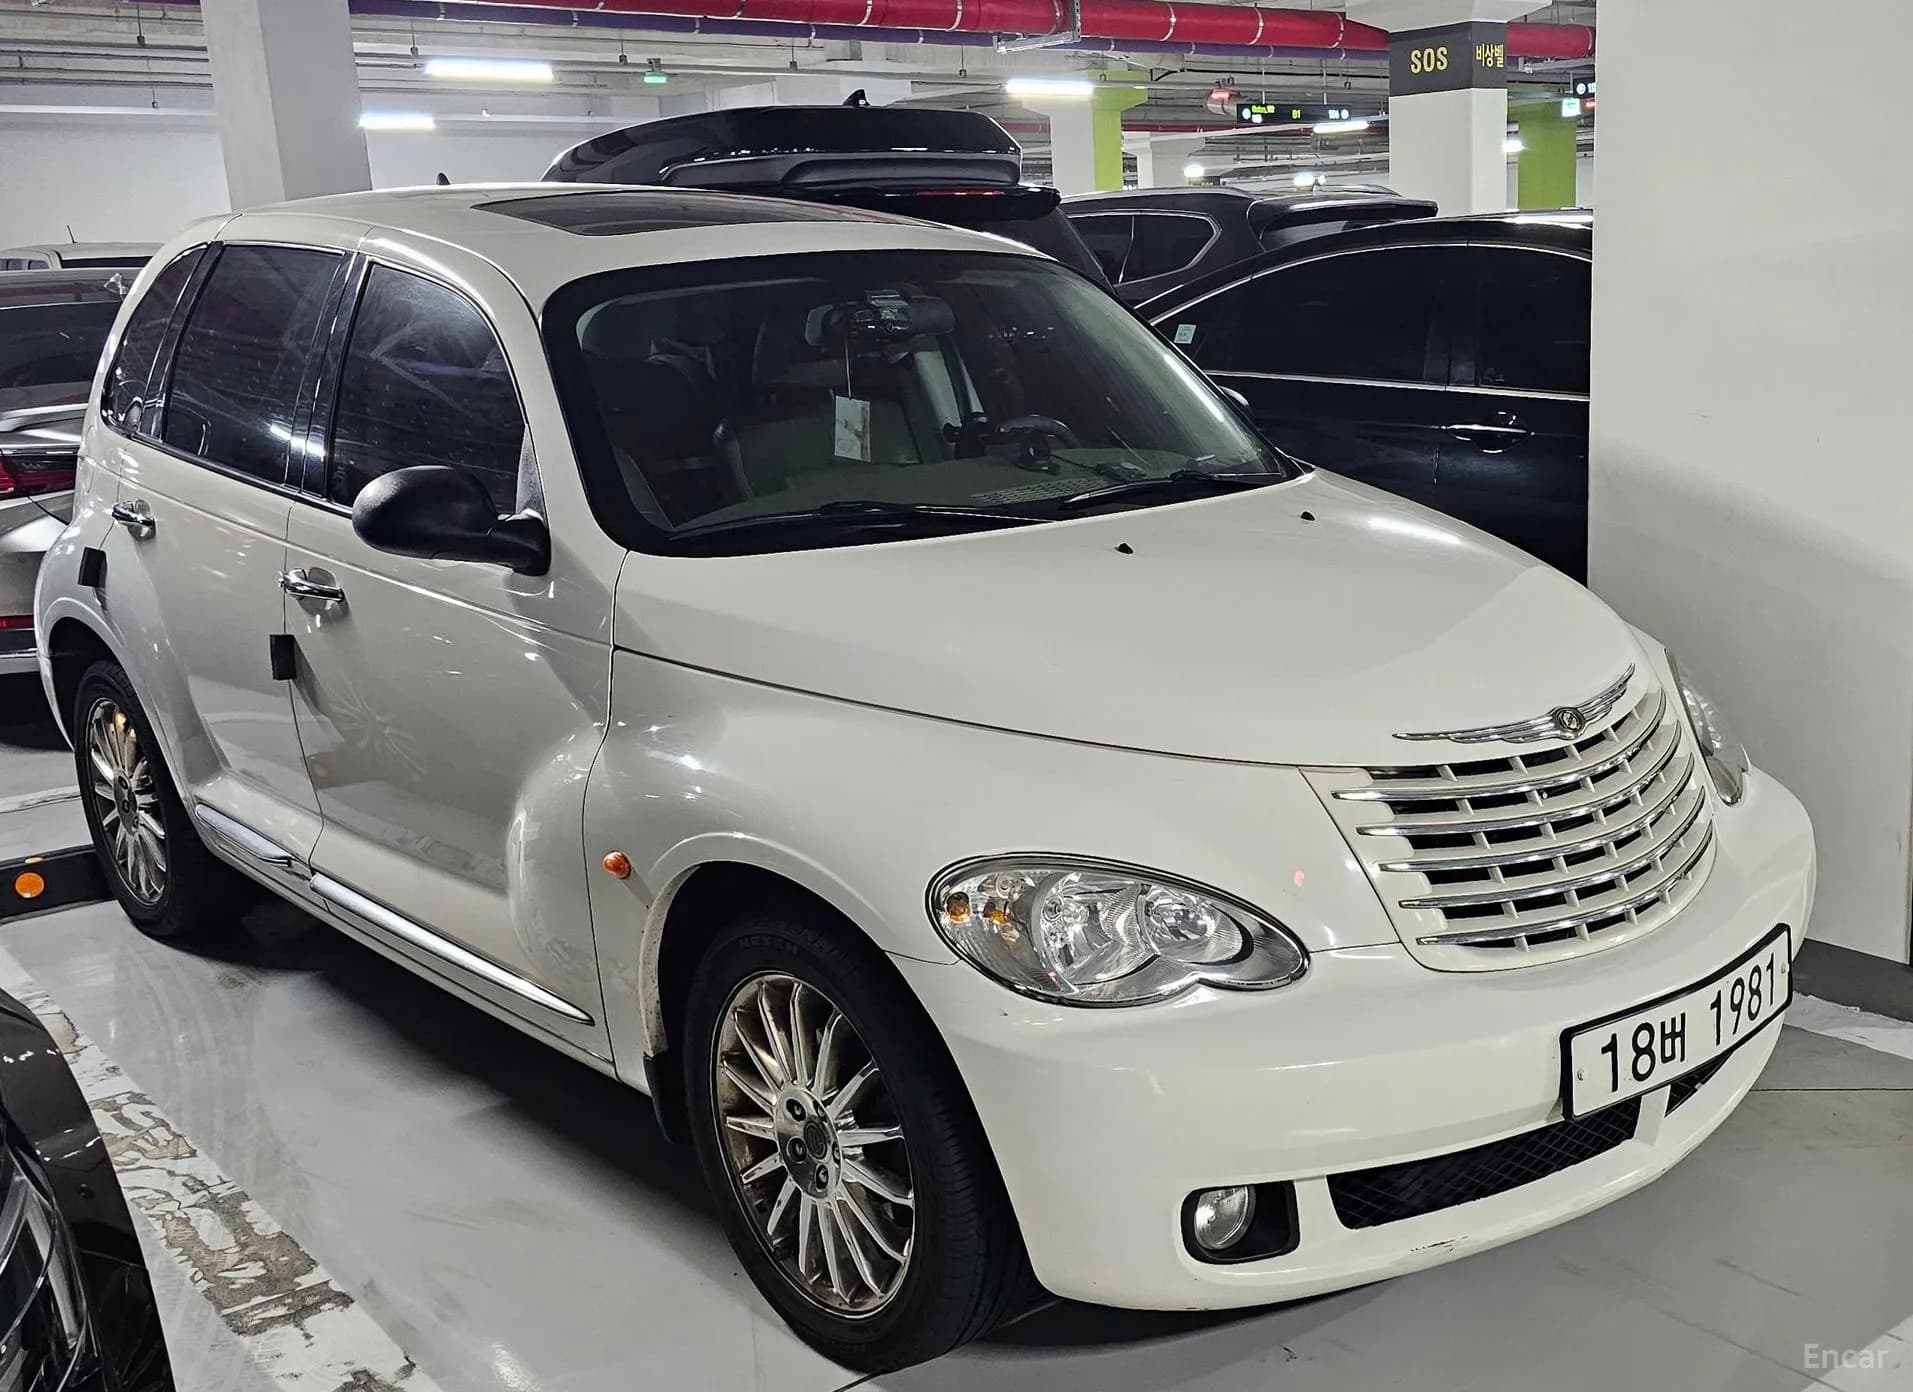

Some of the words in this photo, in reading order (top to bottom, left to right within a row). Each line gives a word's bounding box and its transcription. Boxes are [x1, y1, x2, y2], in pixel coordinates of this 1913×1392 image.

[1411, 46, 1448, 73] SOS
[1475, 43, 1504, 68] 비상벨
[1601, 1012, 1686, 1093] 18버
[1710, 952, 1775, 1046] 1981
